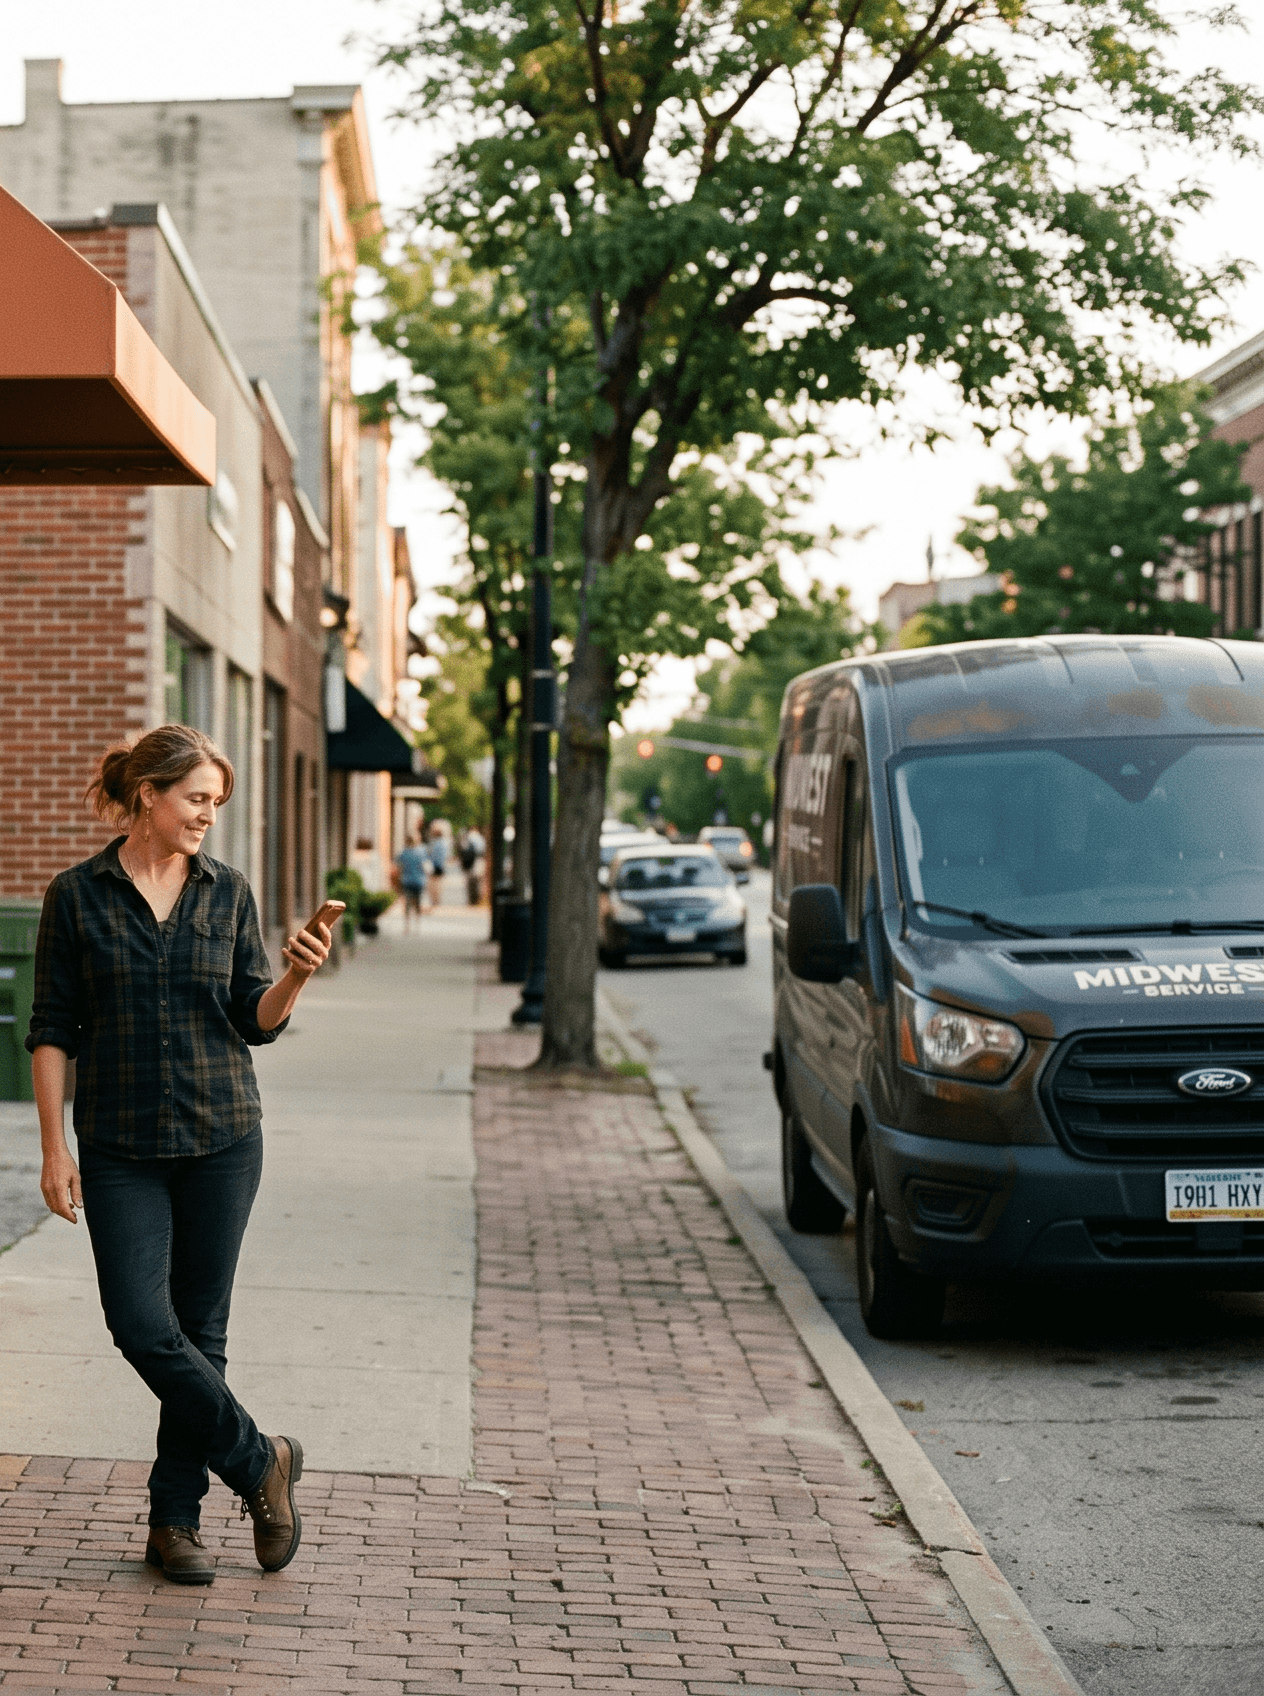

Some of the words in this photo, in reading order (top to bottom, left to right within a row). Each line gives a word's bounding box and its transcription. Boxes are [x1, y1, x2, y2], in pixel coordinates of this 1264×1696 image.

[1073, 963, 1264, 990] MIDWES
[1144, 983, 1245, 997] SERVICE
[1228, 1183, 1262, 1207] HXY
